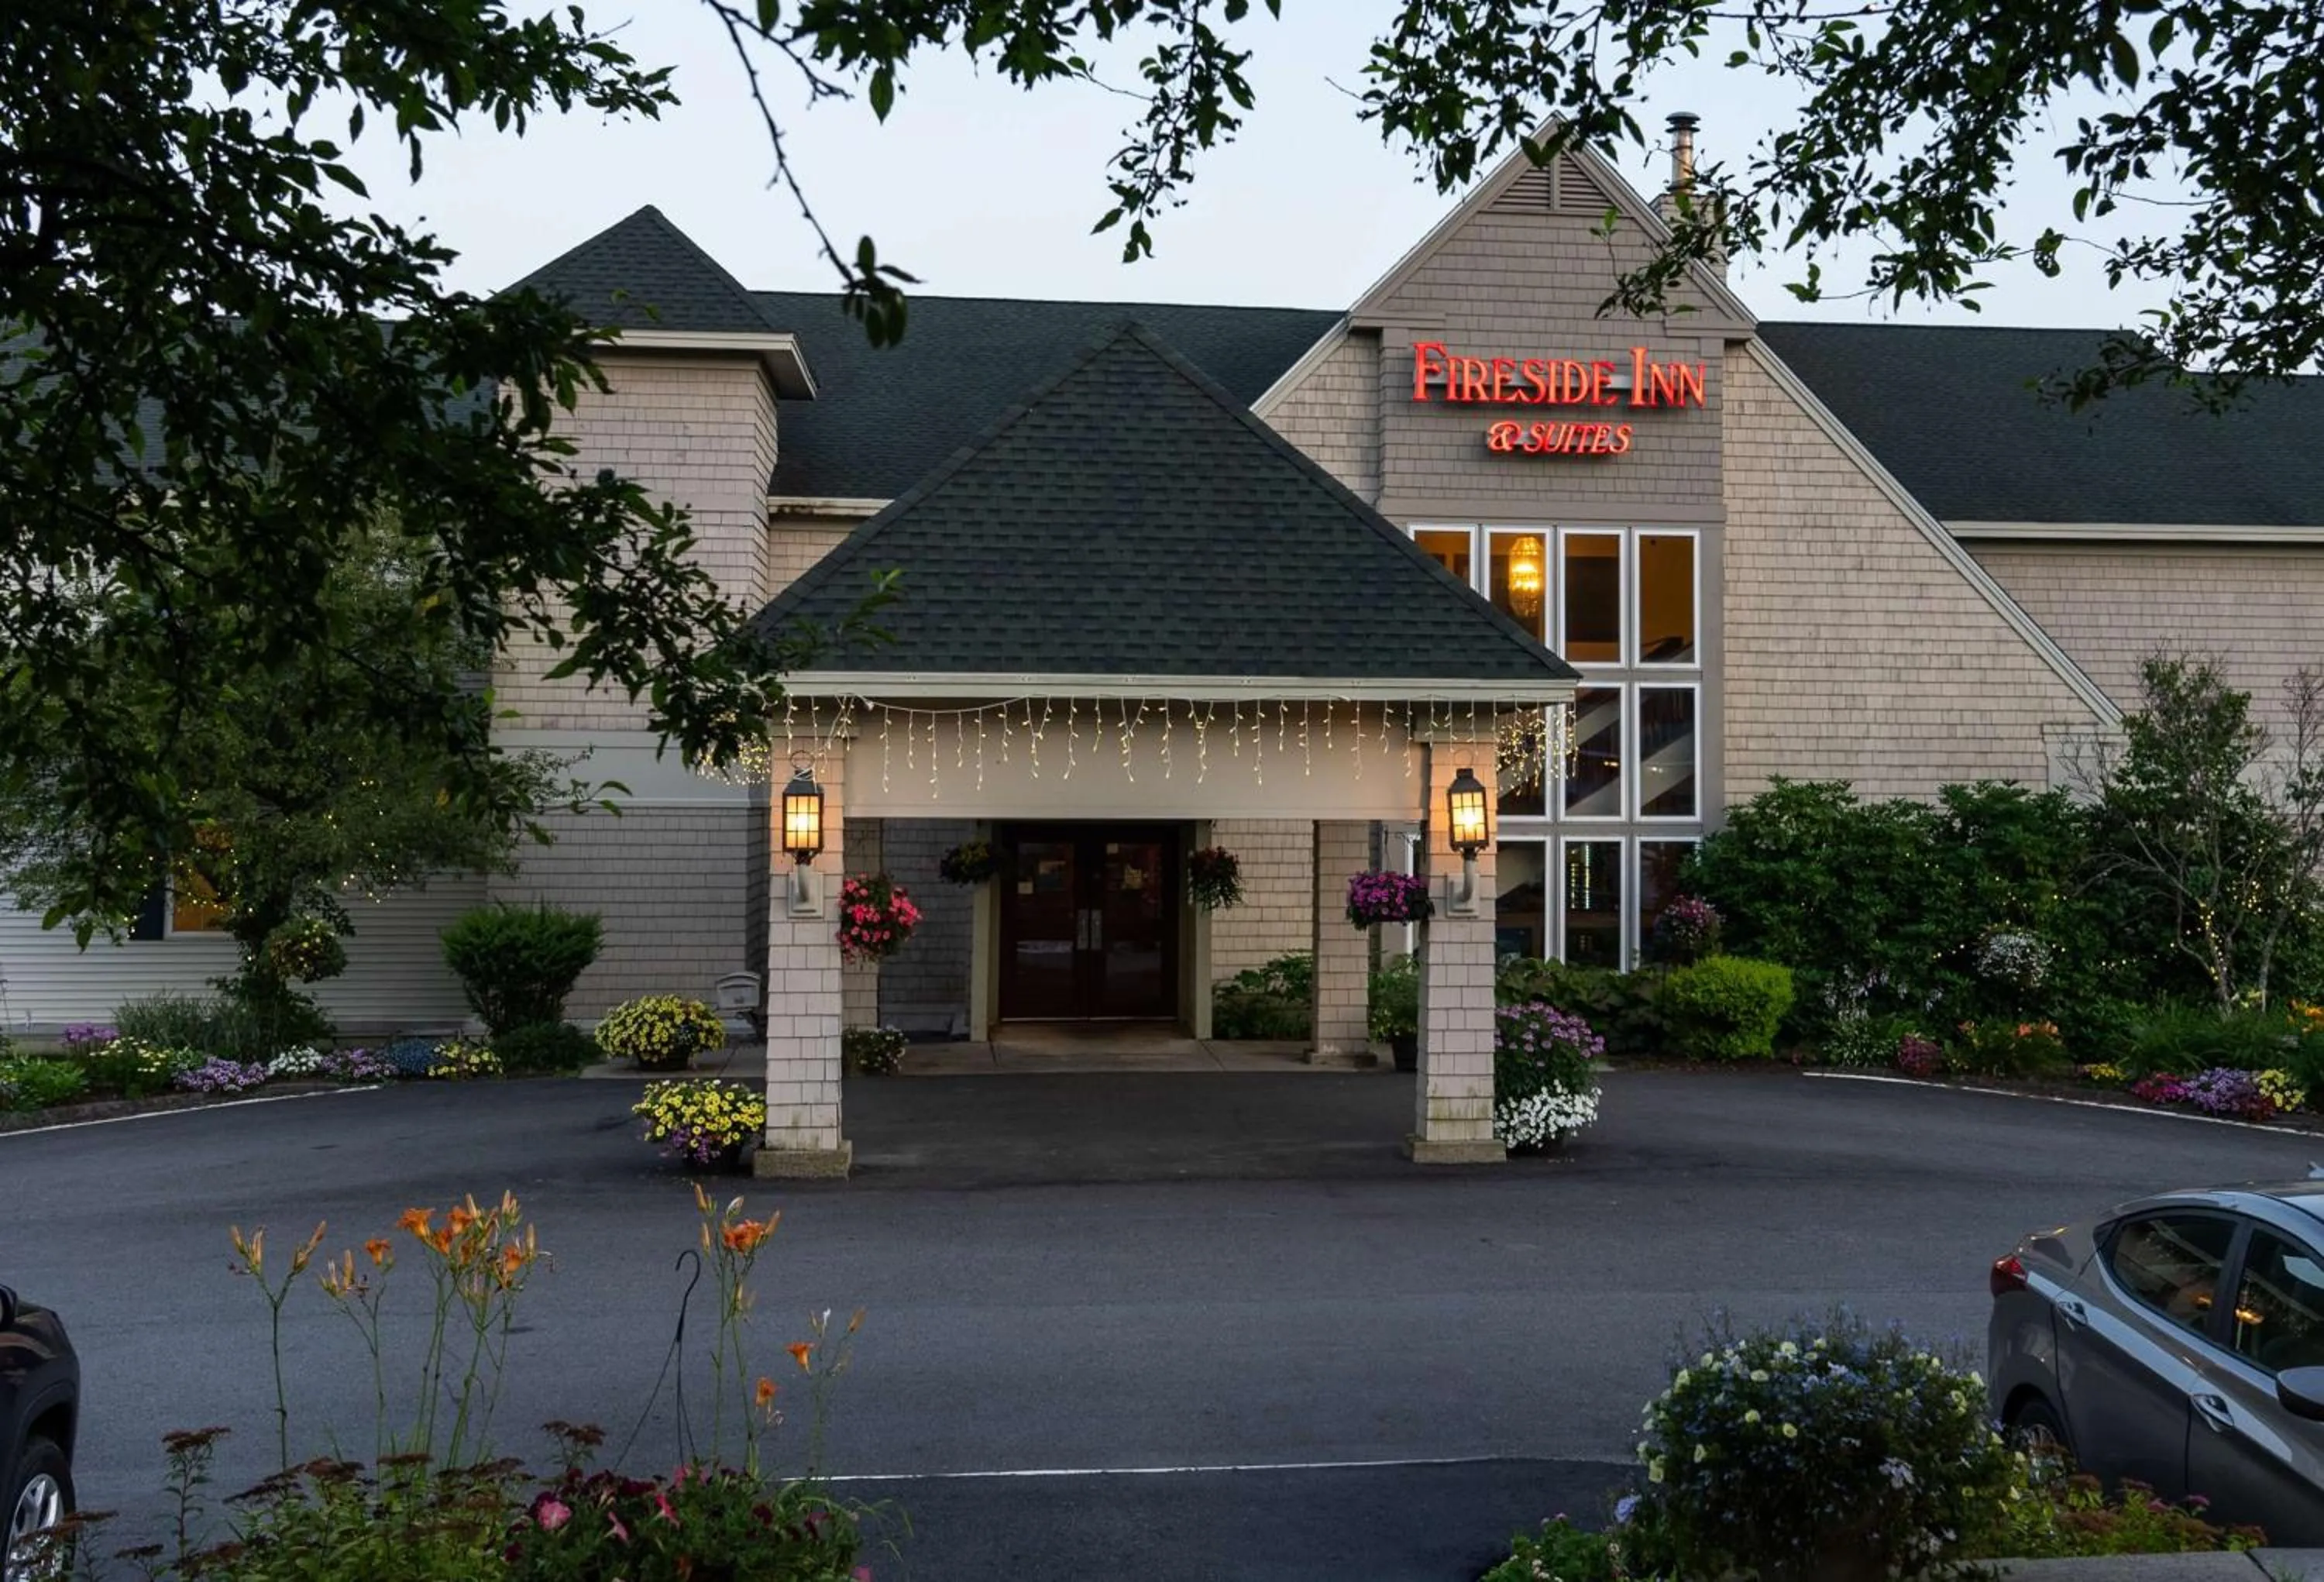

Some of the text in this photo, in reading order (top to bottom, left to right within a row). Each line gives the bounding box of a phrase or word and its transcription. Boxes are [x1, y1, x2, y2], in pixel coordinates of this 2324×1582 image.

[1412, 341, 1705, 409] FIRESIDE INN
[1523, 422, 1633, 454] SUITES
